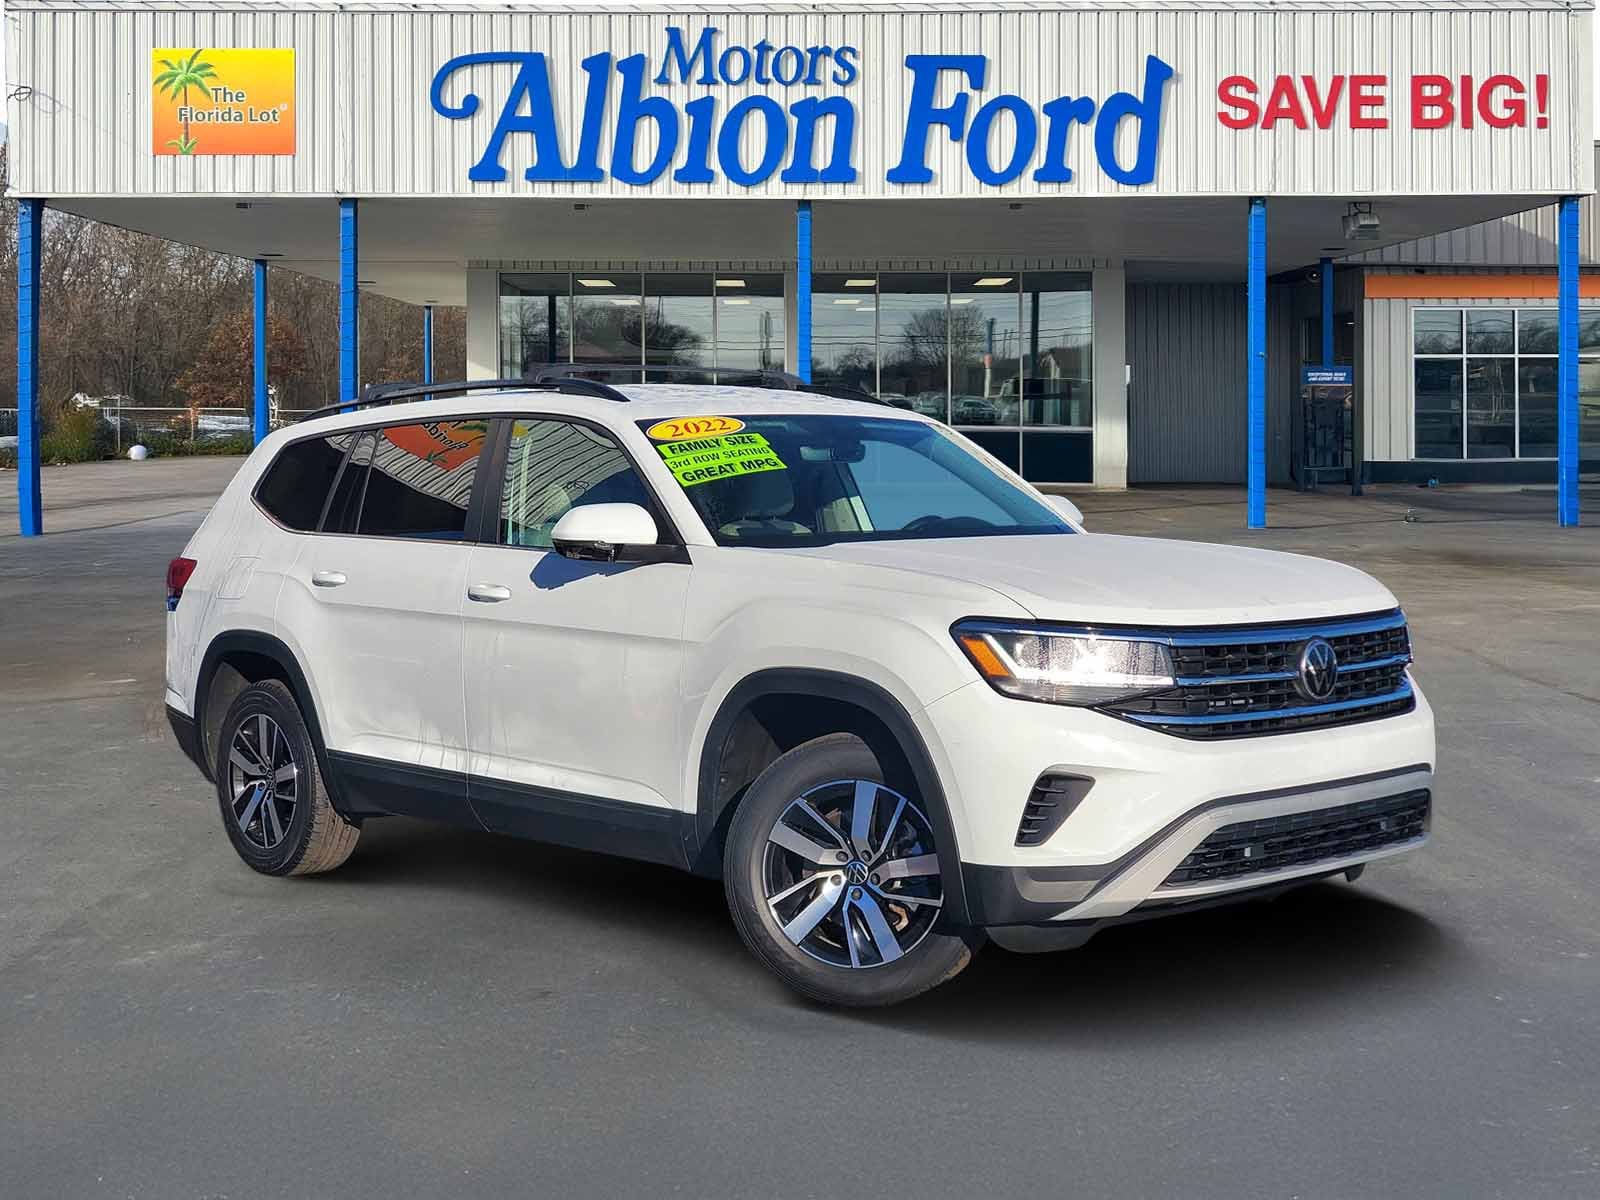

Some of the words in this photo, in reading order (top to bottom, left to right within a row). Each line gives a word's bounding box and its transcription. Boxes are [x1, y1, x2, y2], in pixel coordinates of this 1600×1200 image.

[653, 27, 857, 86] Motors
[211, 87, 246, 103] The
[1217, 74, 1388, 129] SAVE
[1411, 74, 1549, 129] BIG!
[178, 107, 244, 122] Florida
[249, 108, 280, 122] Lot
[430, 51, 857, 186] Albion
[886, 54, 1174, 186] Ford
[666, 418, 732, 438] 2022
[667, 438, 721, 455] FAMILY
[727, 434, 756, 446] SIZE
[670, 457, 690, 469] 3rd
[694, 451, 720, 464] ROW
[722, 446, 770, 459] SEATING
[681, 463, 737, 482] GREAT
[741, 457, 779, 472] MPG
